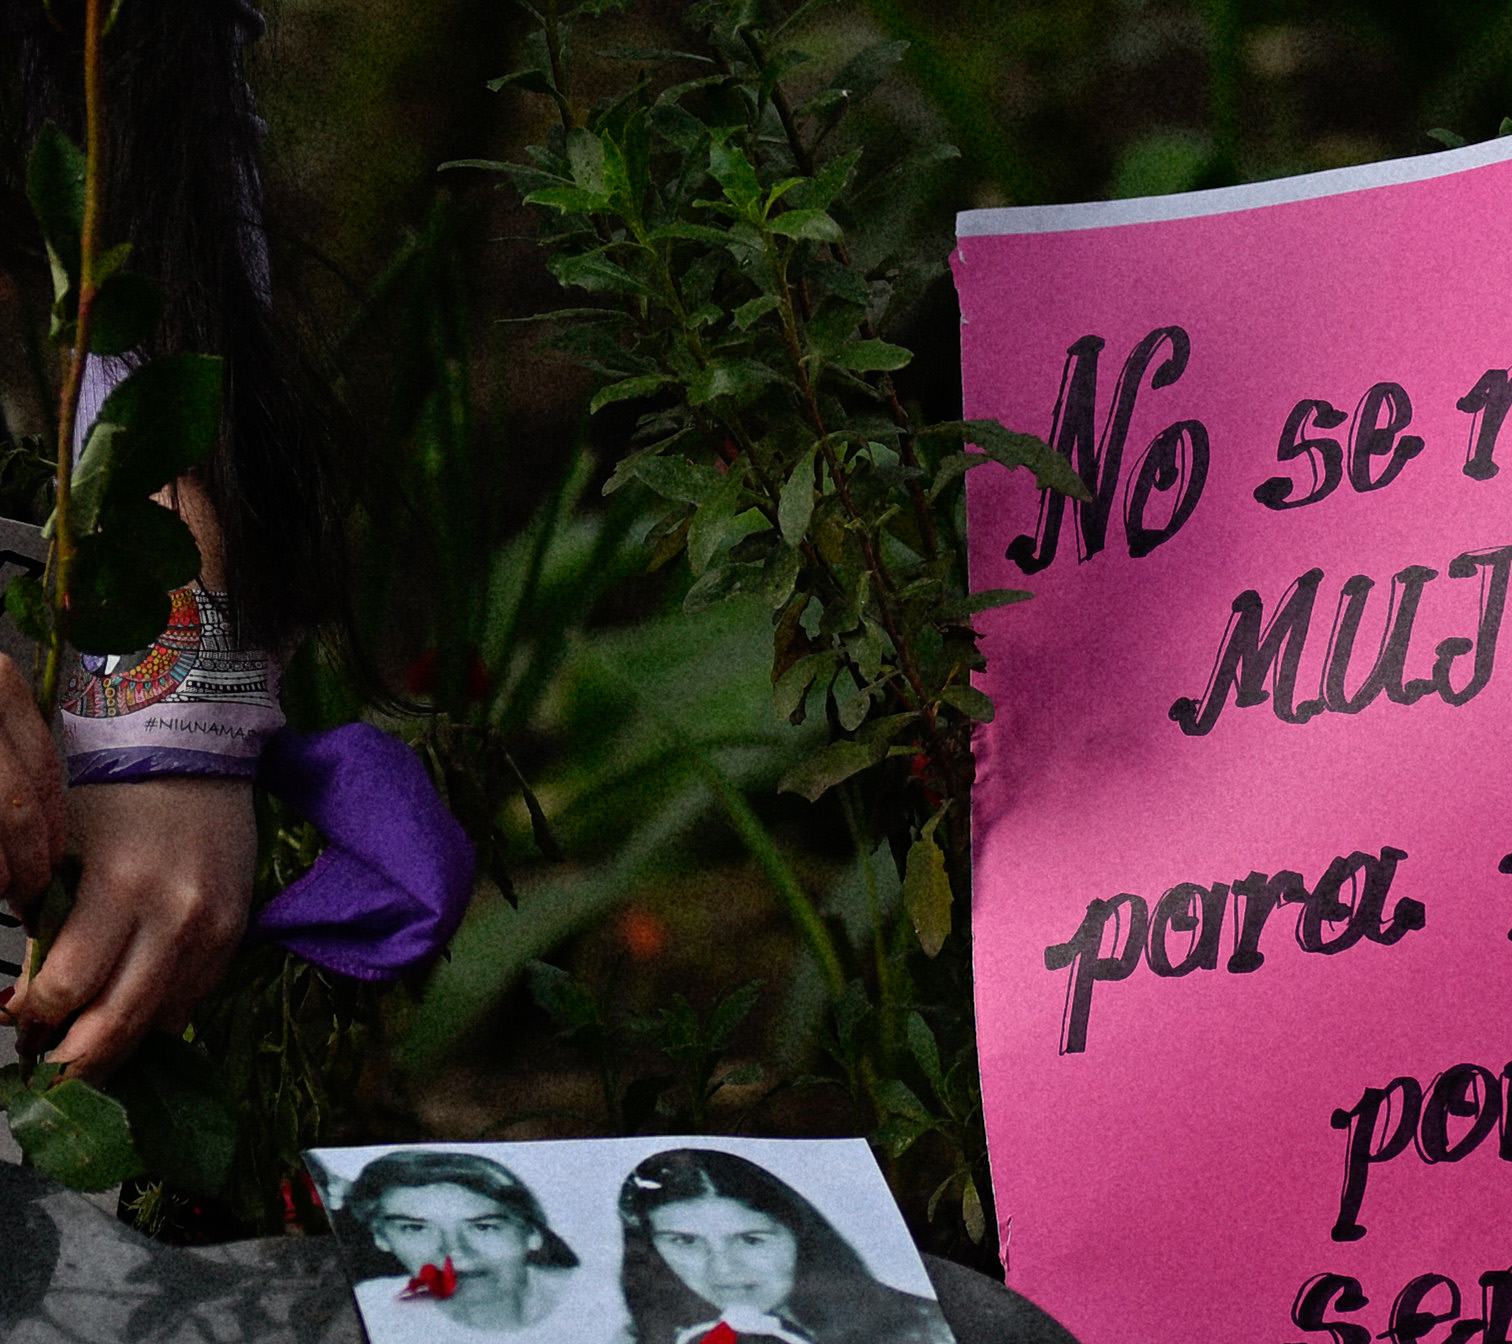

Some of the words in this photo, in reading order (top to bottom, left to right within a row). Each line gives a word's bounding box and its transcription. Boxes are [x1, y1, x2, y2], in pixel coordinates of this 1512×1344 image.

[1006, 325, 1210, 574] No
[1254, 380, 1424, 512] se
[1045, 848, 1424, 1055] para
